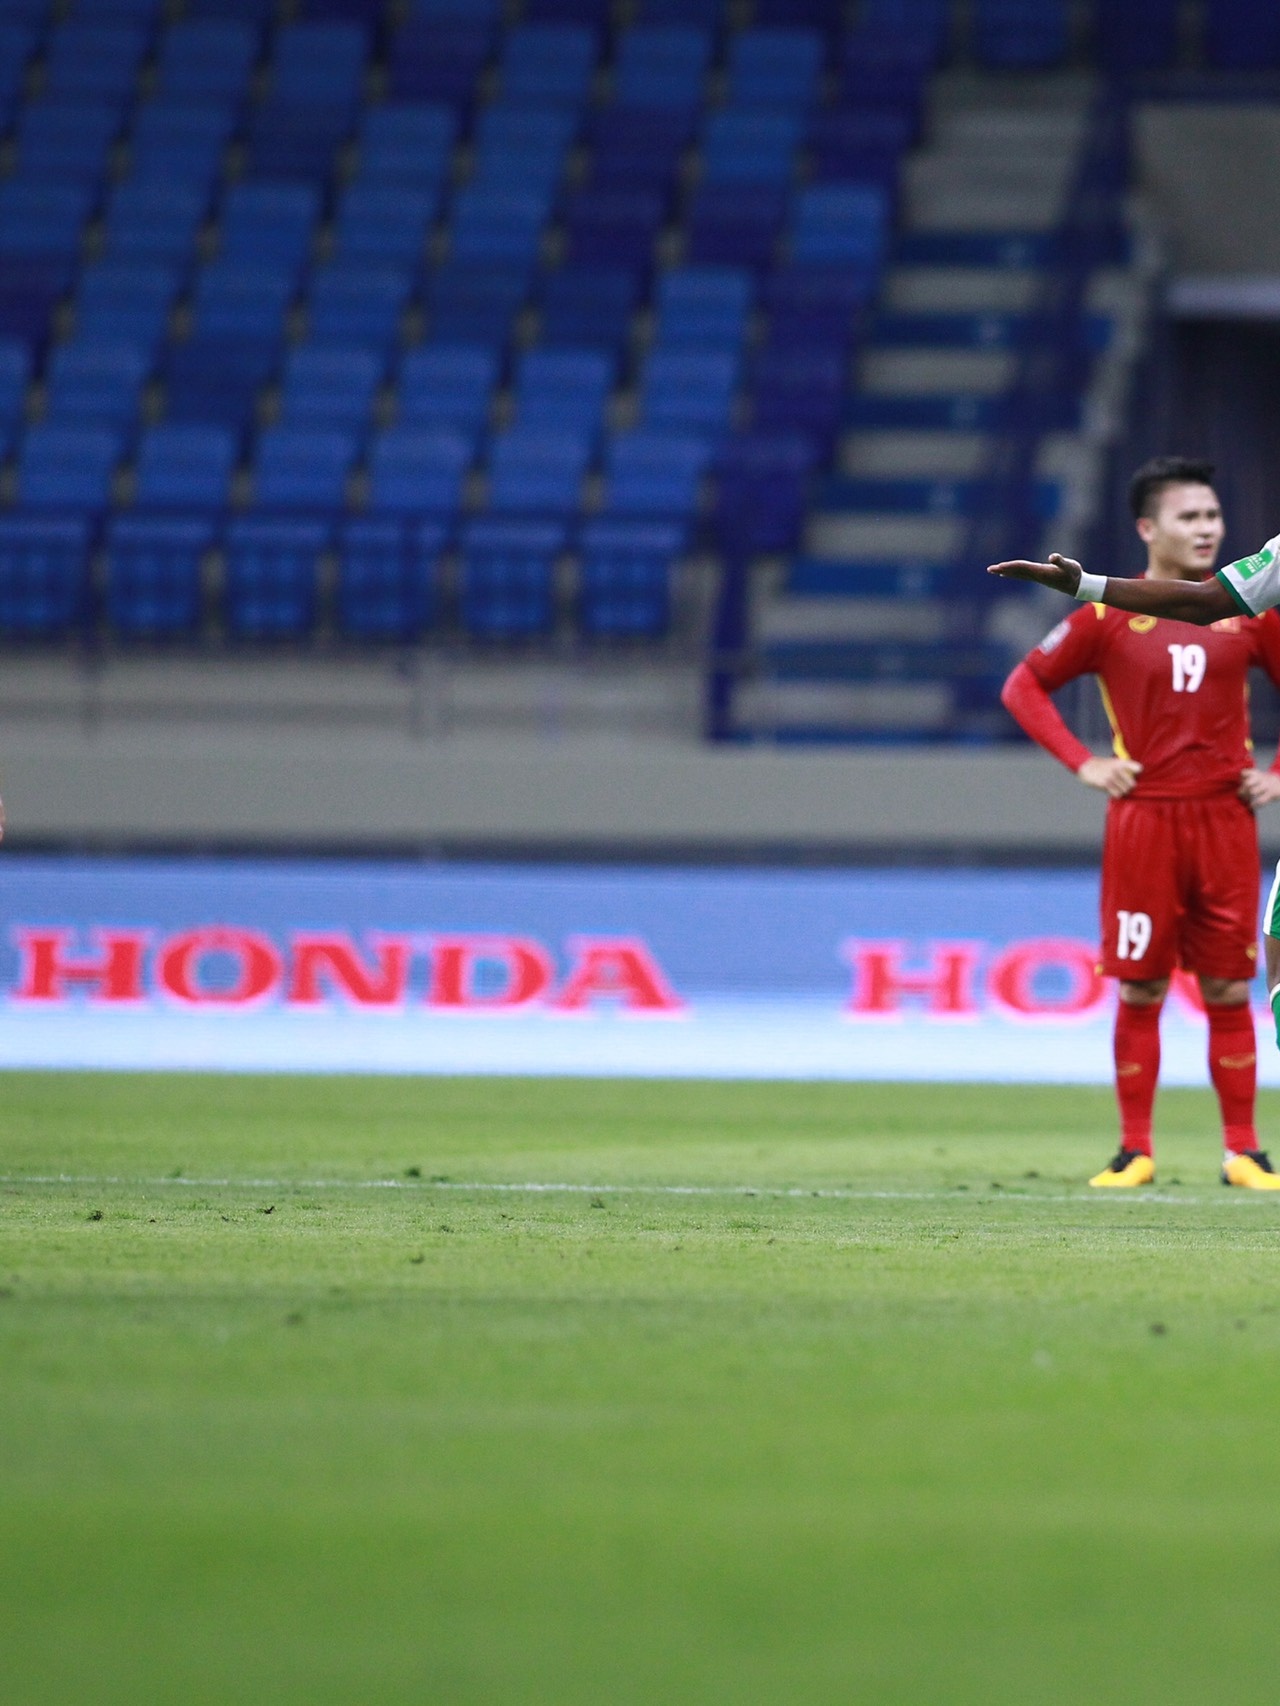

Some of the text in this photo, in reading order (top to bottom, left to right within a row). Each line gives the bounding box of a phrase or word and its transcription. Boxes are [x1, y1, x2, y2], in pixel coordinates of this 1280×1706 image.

[1168, 643, 1207, 693] 19
[1116, 909, 1153, 961] 19
[12, 926, 690, 1016] HONDA
